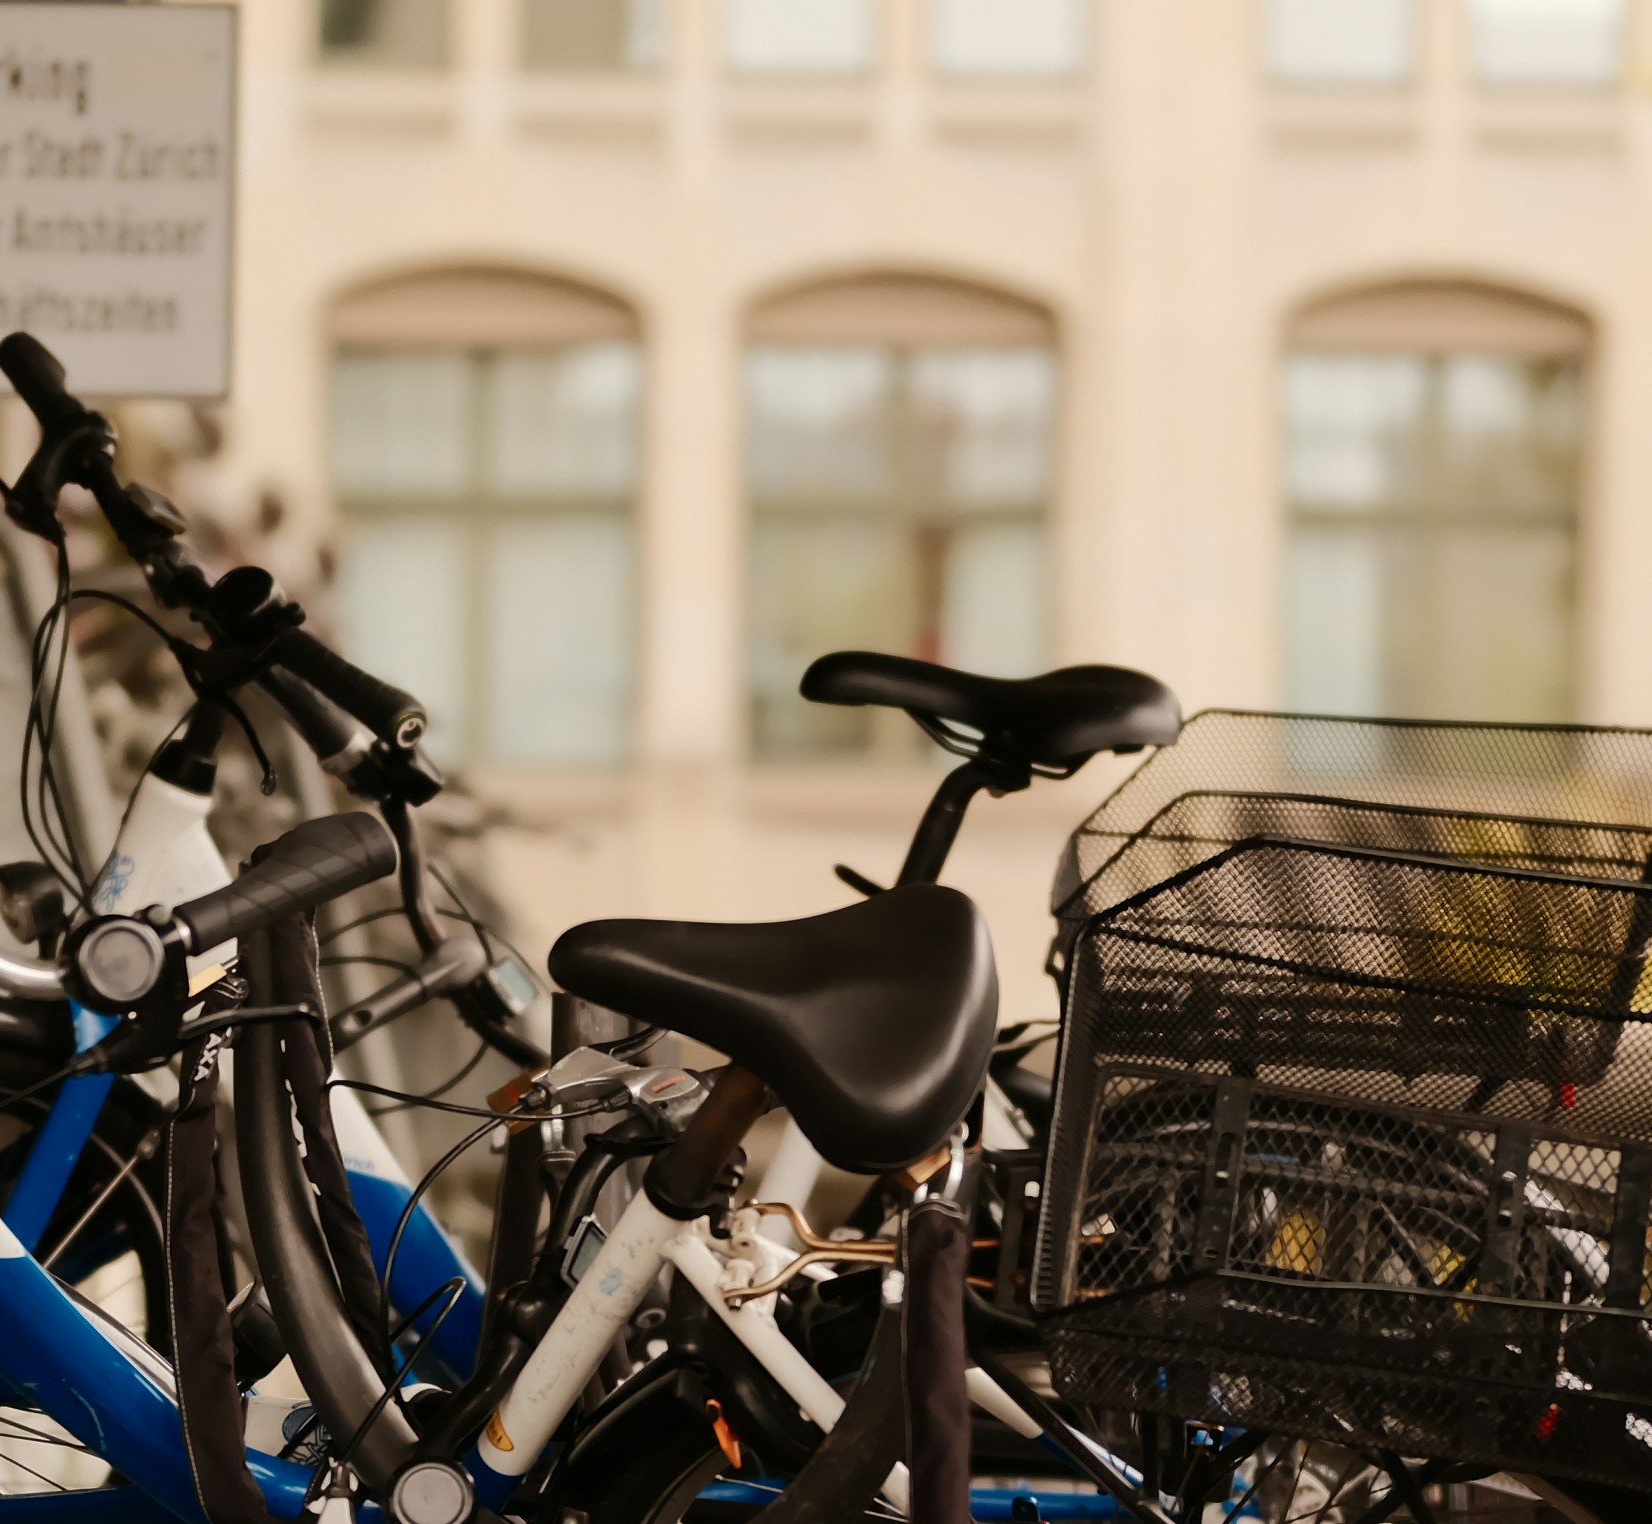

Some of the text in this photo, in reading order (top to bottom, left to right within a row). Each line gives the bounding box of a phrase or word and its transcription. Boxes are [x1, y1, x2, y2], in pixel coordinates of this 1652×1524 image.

[20, 132, 105, 179] Stadt
[113, 131, 217, 180] Zürich
[193, 1032, 223, 1082] AXA
